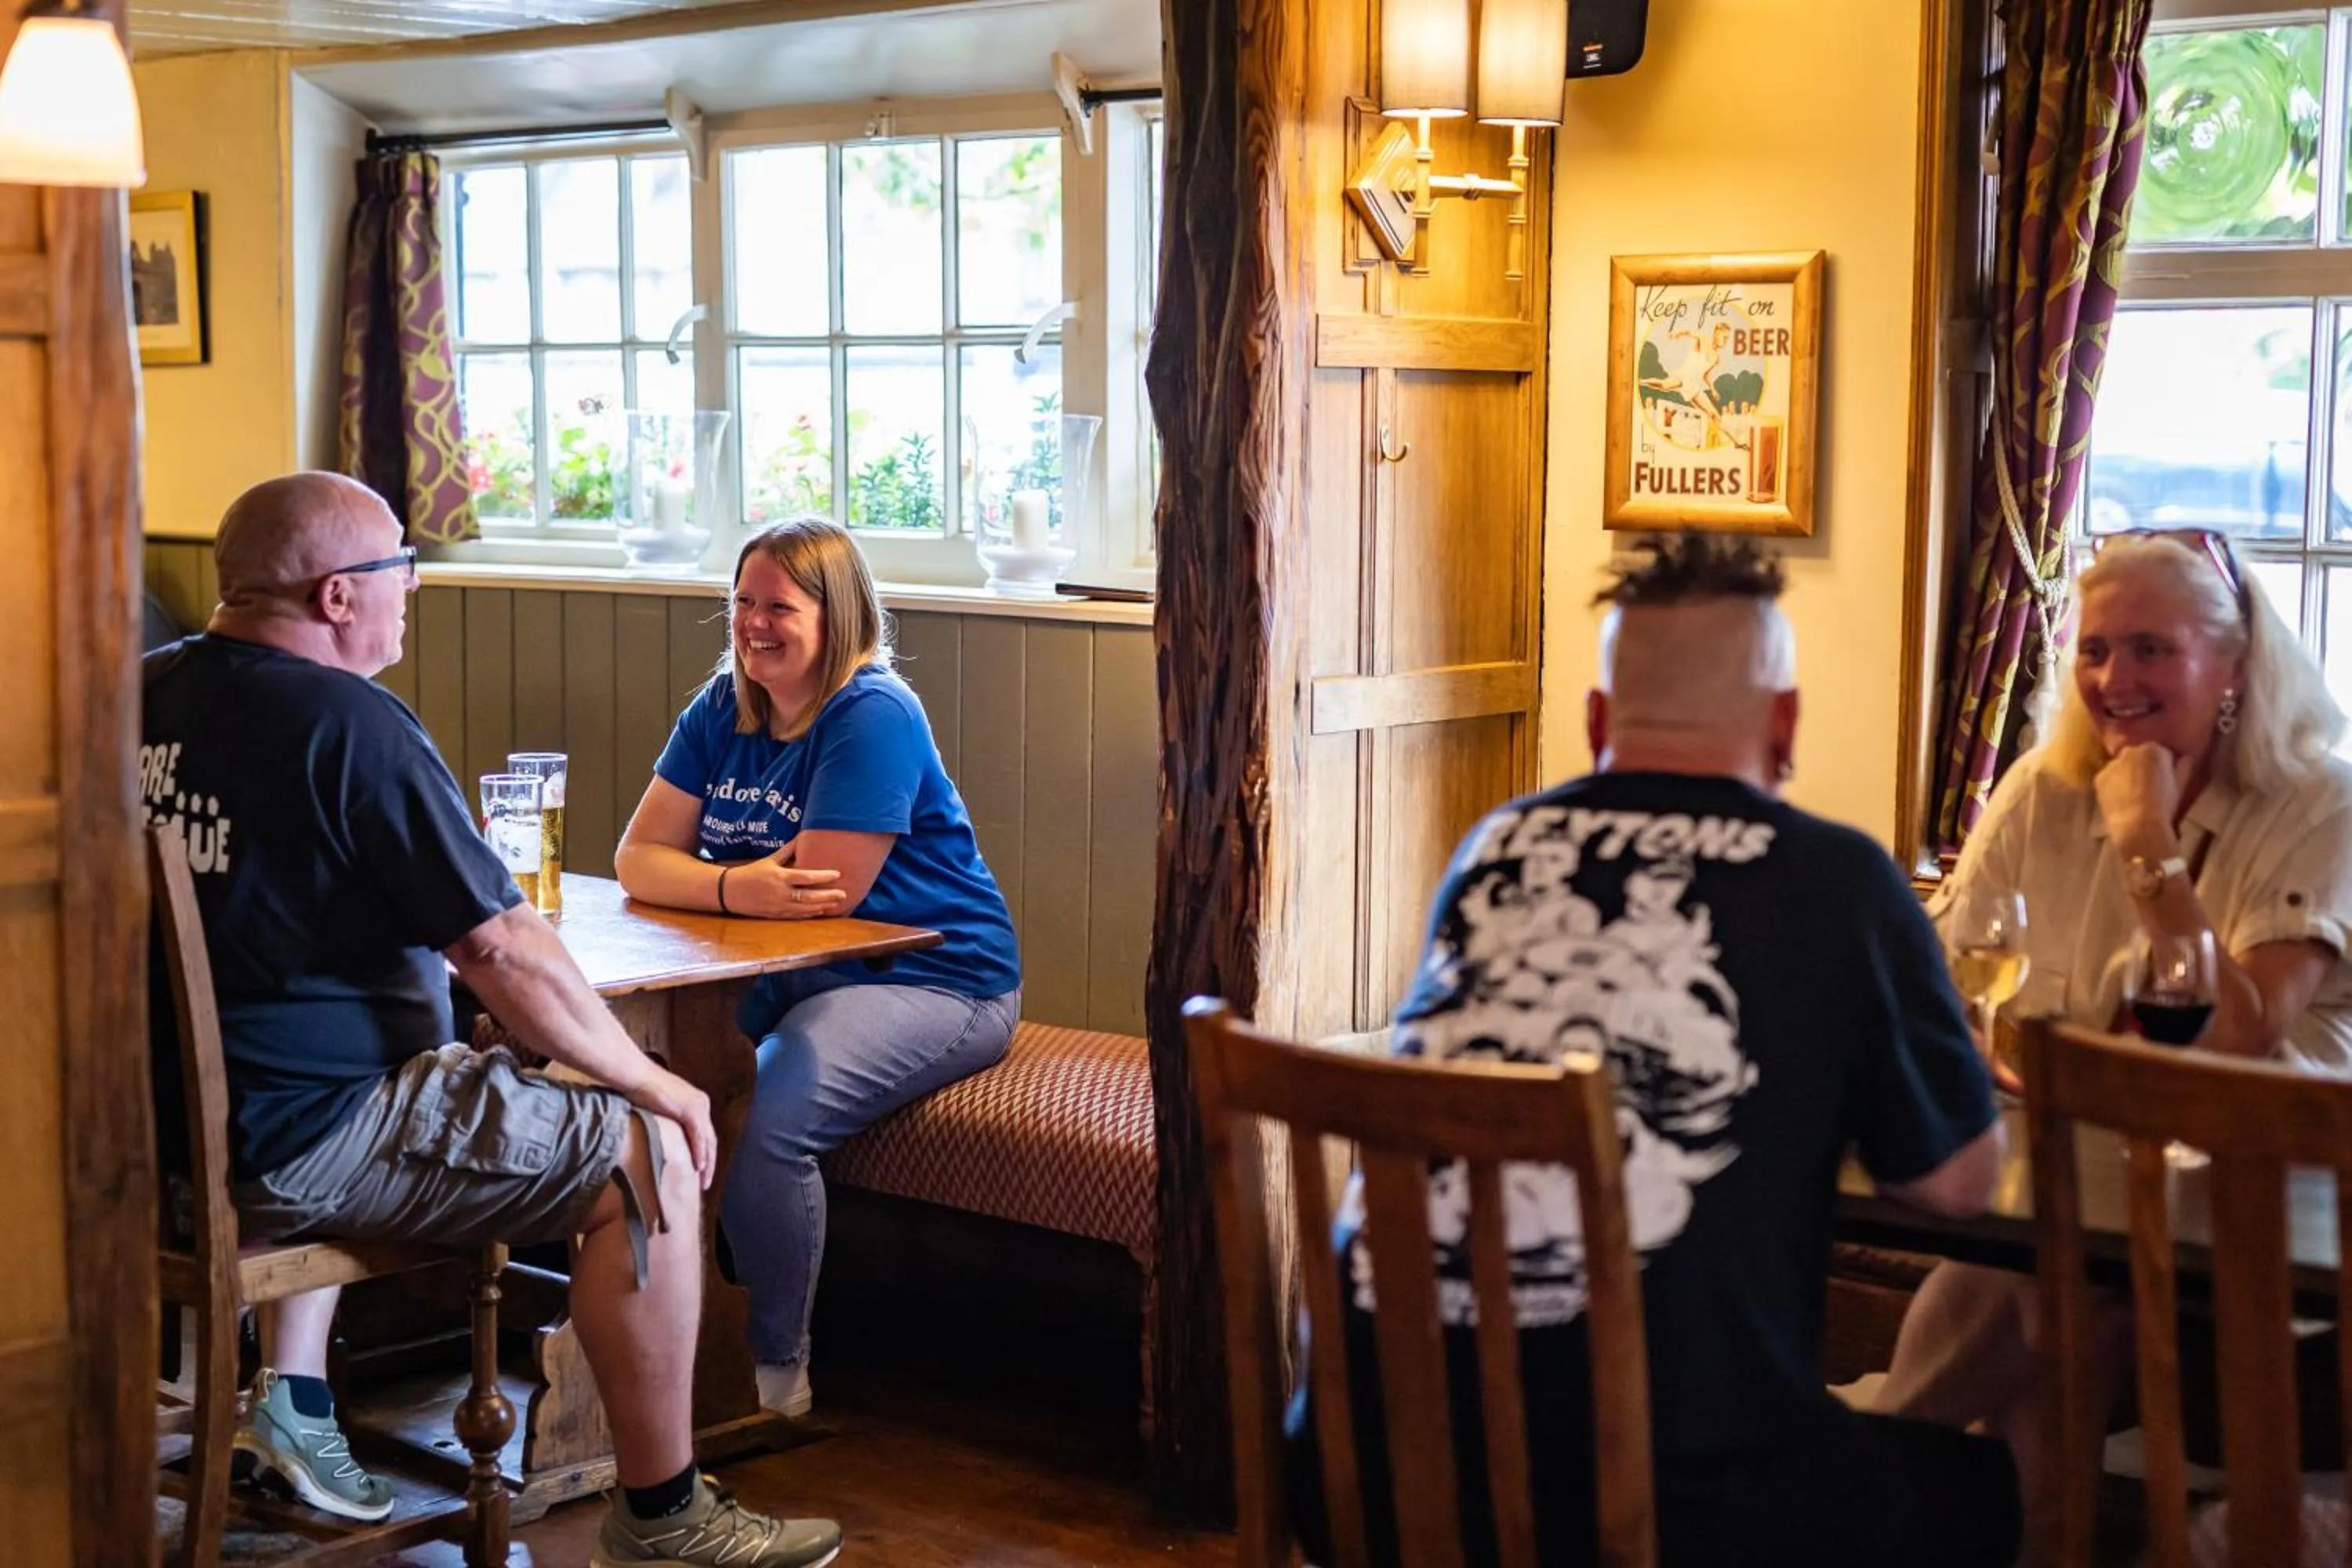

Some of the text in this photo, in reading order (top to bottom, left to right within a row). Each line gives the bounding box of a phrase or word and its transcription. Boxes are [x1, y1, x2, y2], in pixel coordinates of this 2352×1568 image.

[1640, 285, 1774, 332] Keep fit on
[1733, 328, 1790, 357] BEER
[1635, 462, 1741, 495] FULLERS
